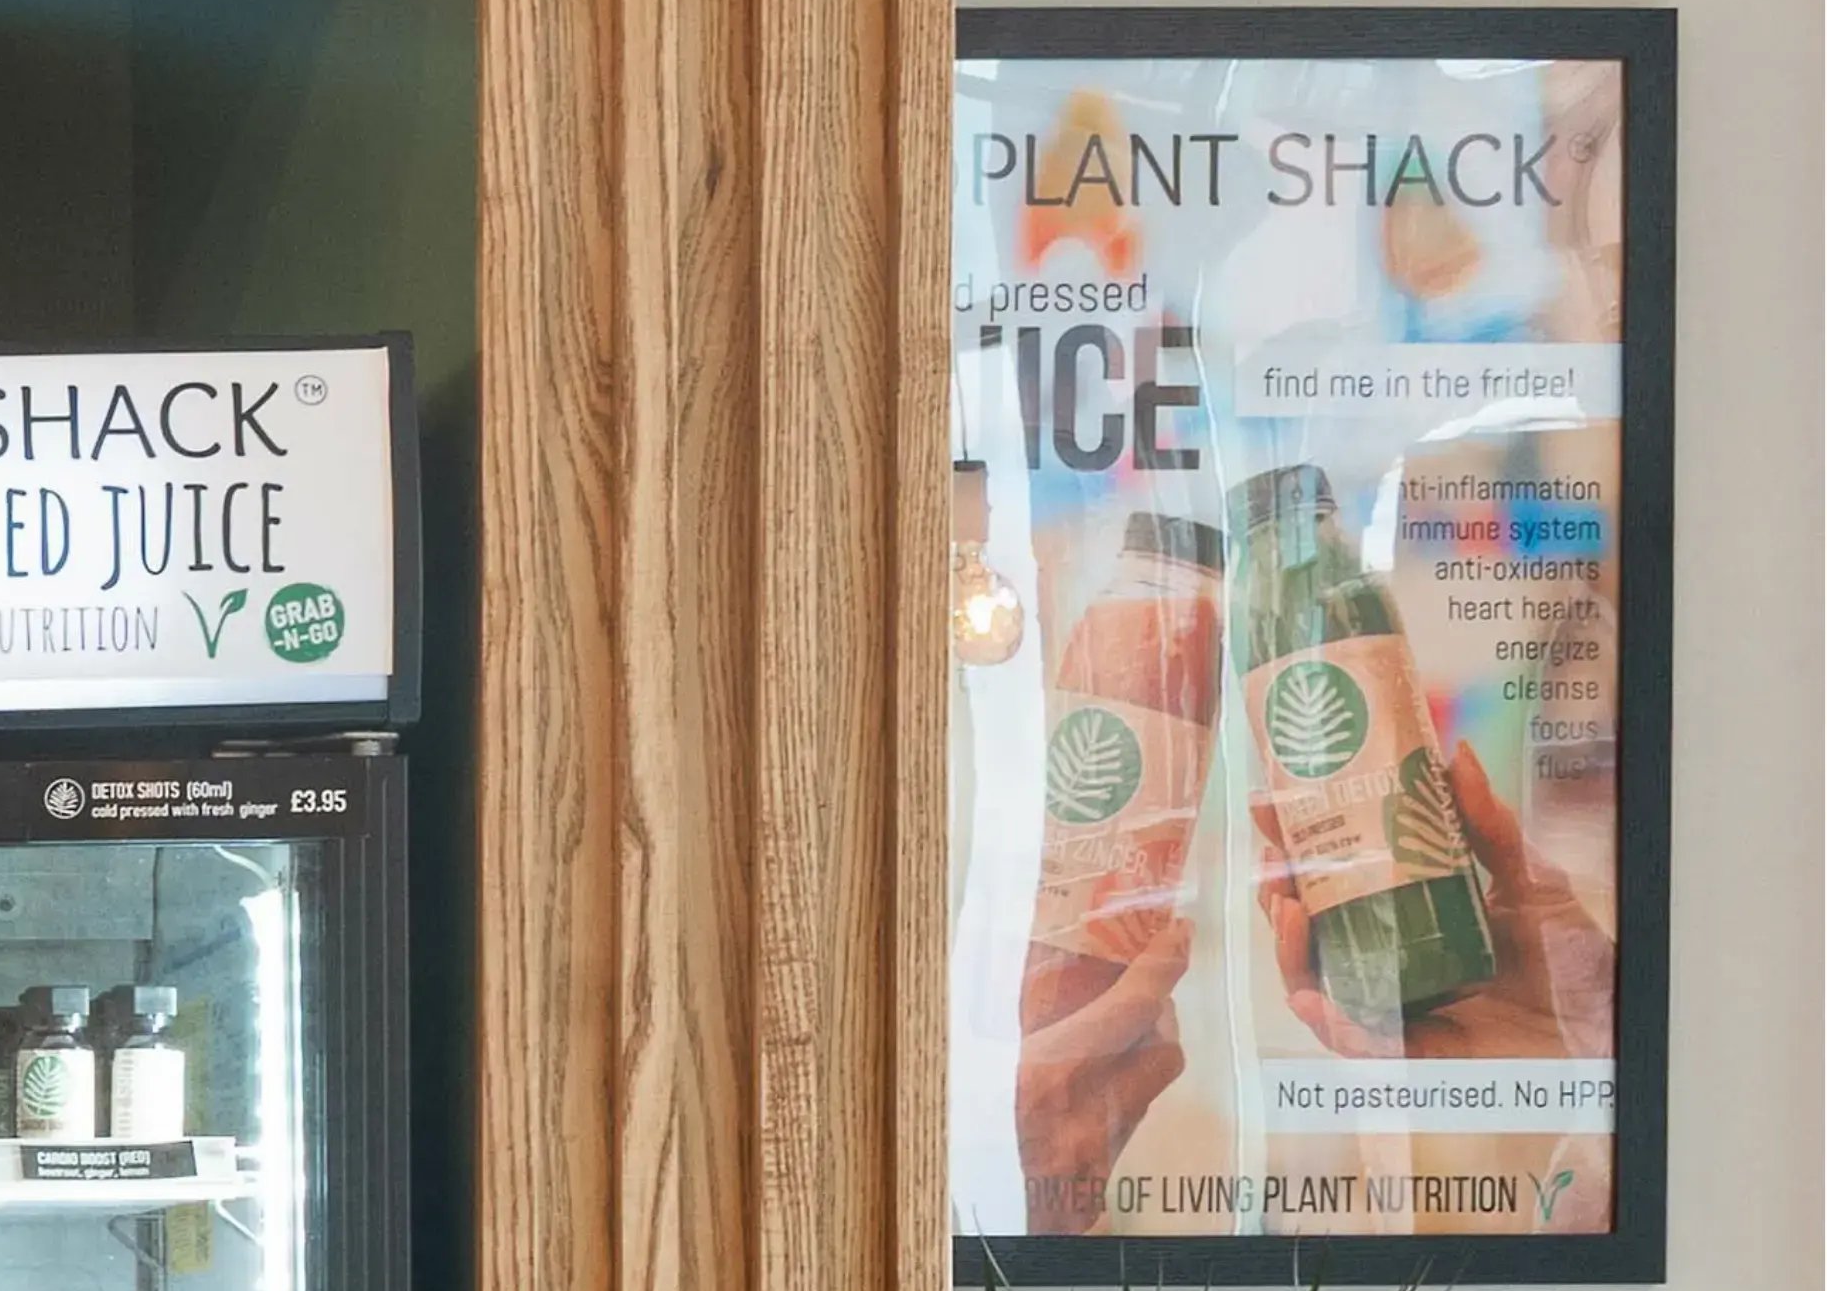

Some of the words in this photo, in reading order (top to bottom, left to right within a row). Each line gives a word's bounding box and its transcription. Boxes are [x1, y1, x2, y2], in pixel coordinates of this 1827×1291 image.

[971, 133, 1238, 207] PLANT
[1268, 132, 1562, 207] SHACK
[990, 275, 1147, 320] pressed
[1264, 369, 1318, 398] find
[1330, 375, 1375, 397] me
[1386, 371, 1413, 397] in
[1423, 369, 1470, 397] the
[1481, 368, 1574, 398] fridge!
[100, 481, 286, 591] JUICE
[1403, 518, 1500, 541] immune
[1510, 518, 1600, 546] system
[1435, 556, 1600, 581] anti-oxidants
[271, 597, 335, 628] GRAB
[1448, 596, 1512, 621] heart
[273, 623, 339, 649] -N-GO
[1496, 638, 1598, 666] energize
[1503, 677, 1598, 701] cleanse
[1531, 715, 1597, 741] focus
[91, 781, 132, 800] DETOX
[136, 781, 180, 800] SHOTS
[291, 789, 346, 813] £3.95
[1278, 1081, 1324, 1109] Not
[1334, 1080, 1504, 1114] pasteurised.
[1514, 1081, 1547, 1108] No
[1558, 1080, 1614, 1108] HPP.
[1118, 1177, 1153, 1214] OF
[1162, 1177, 1254, 1213] LIVING
[1263, 1176, 1358, 1212] PLANT
[1367, 1176, 1517, 1213] NUTRITION
